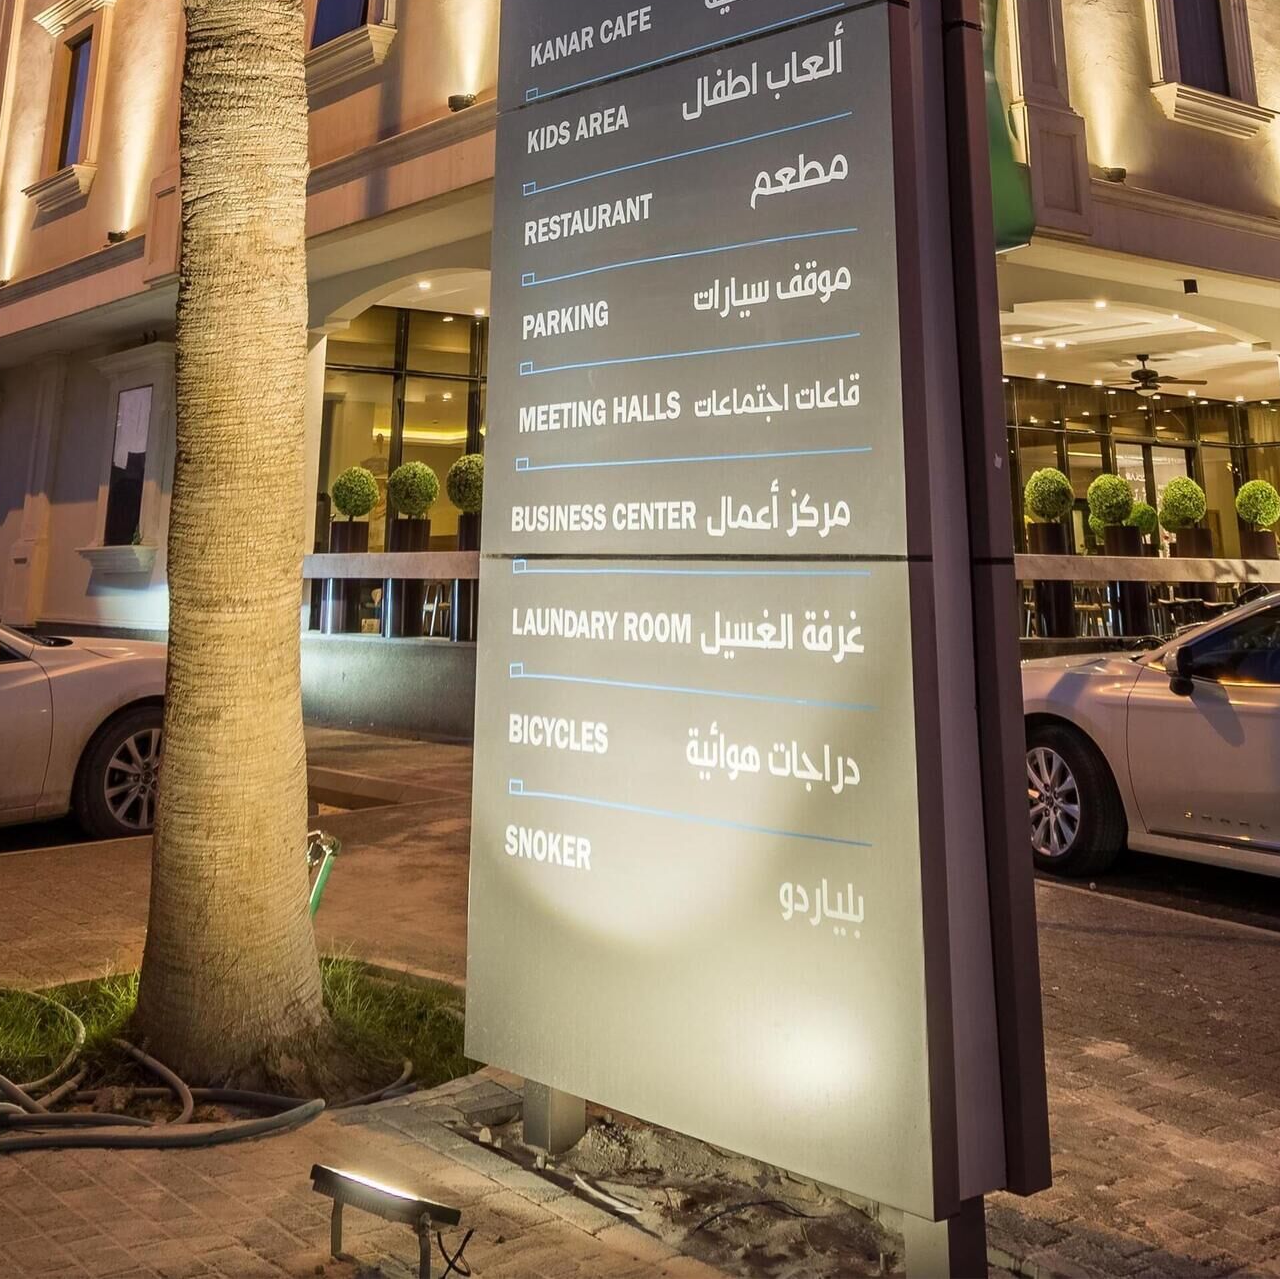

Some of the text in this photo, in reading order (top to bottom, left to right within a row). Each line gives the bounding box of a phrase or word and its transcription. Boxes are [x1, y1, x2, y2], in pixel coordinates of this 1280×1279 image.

[530, 5, 652, 68] KANAR CAFE
[682, 21, 845, 121] ألعاب اطفال
[527, 105, 629, 154] KIDS AREA
[750, 153, 849, 210] مطعم
[524, 193, 653, 245] RESTAURANT
[693, 260, 851, 318] موقف سيارات
[522, 300, 609, 340] PARKING
[519, 391, 681, 433] MEETING HALLS
[694, 372, 860, 423] قاعات اجتماعات
[511, 500, 696, 532] BUSINESS CENTER
[707, 478, 850, 537] مركز أعمال
[512, 608, 691, 644] LAUNDARY ROOM
[700, 609, 865, 663] غرفة الغسيل
[508, 713, 609, 754] BICYCLES
[686, 720, 860, 794] دراجات هوائية
[504, 824, 592, 870] SNOKER
[779, 878, 865, 938] بلياردو
